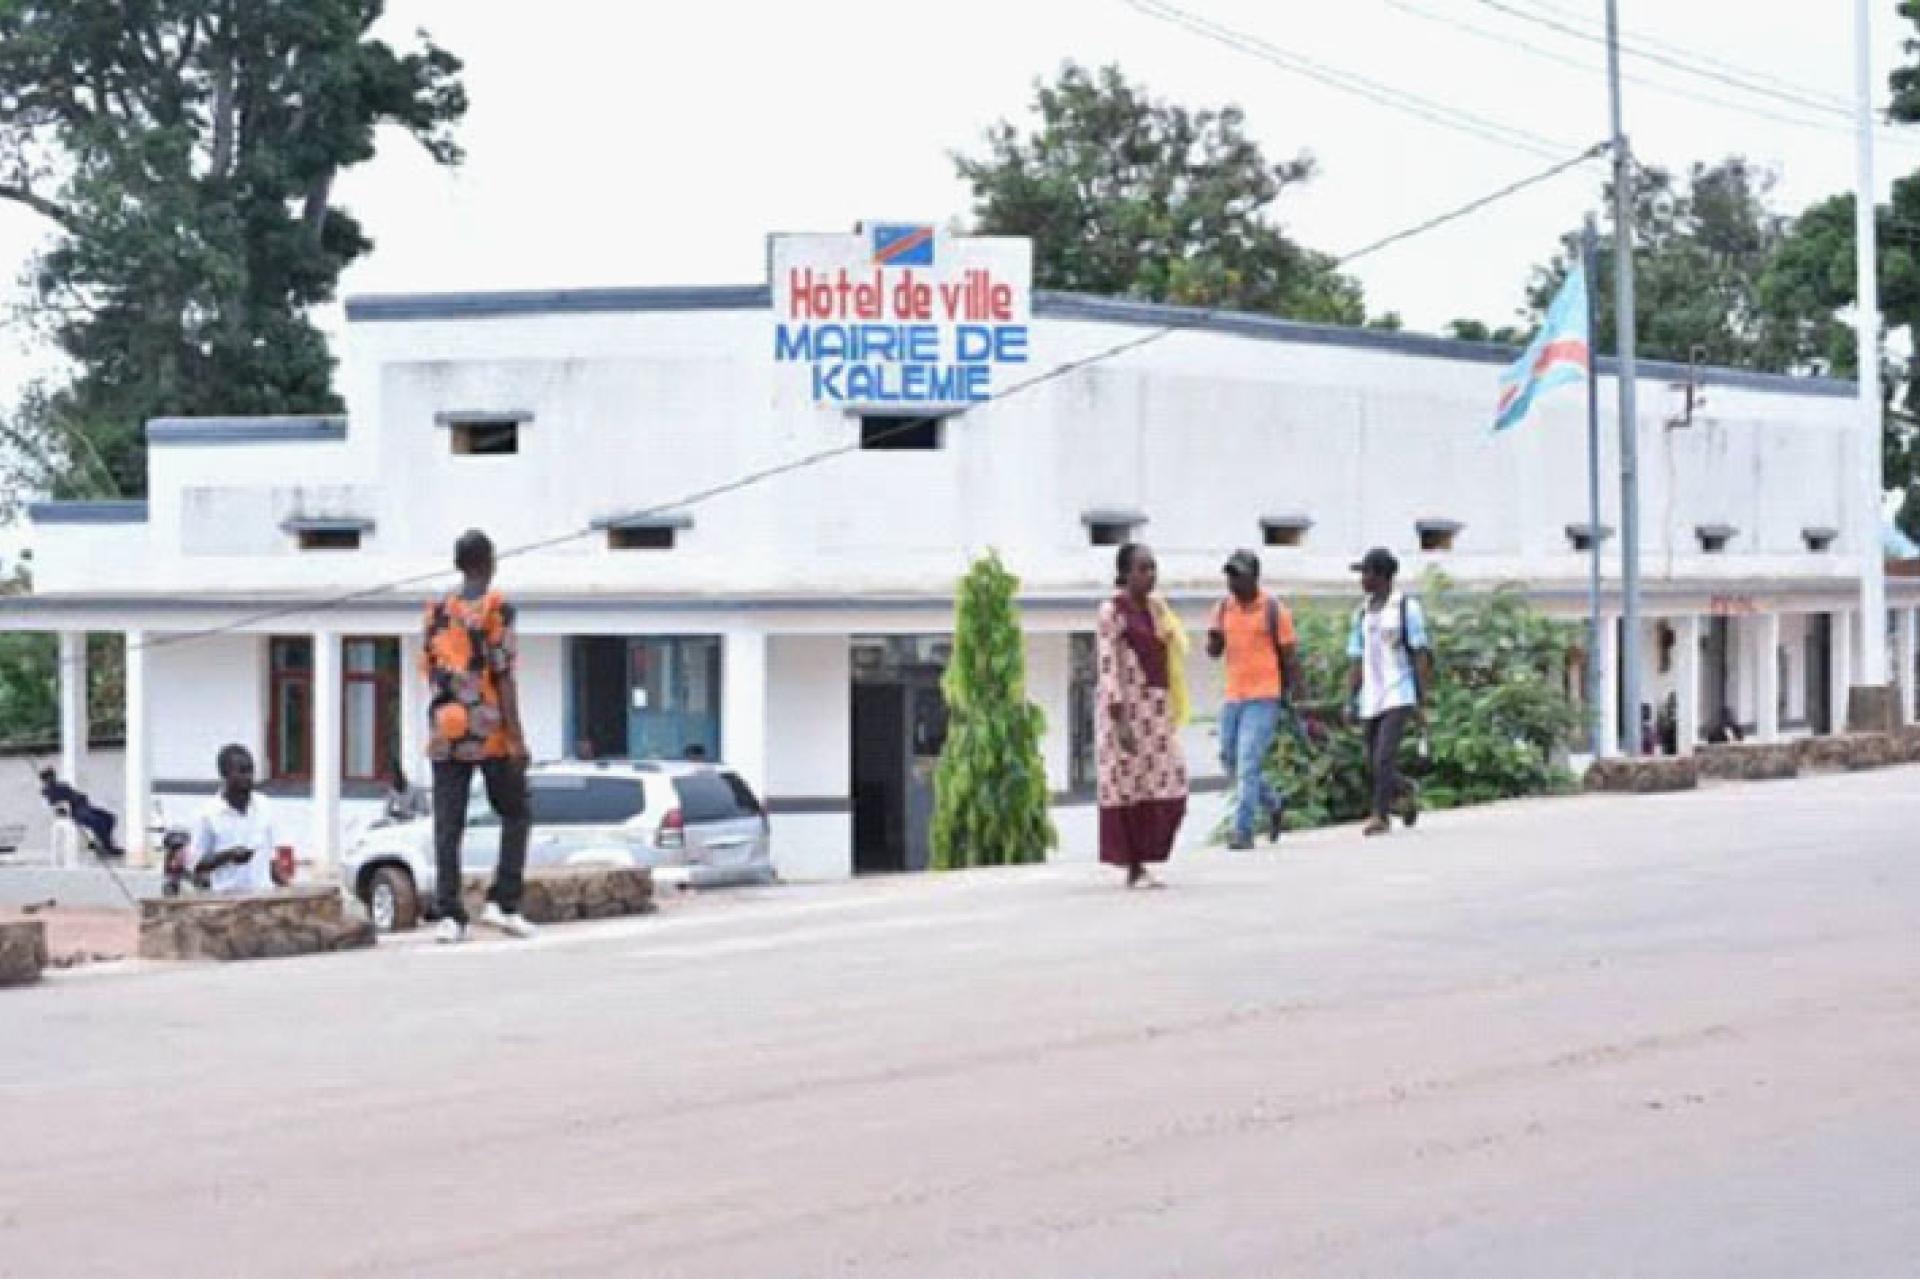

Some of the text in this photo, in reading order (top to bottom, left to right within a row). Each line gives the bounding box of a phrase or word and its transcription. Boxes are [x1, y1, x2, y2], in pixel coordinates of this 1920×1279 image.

[894, 267, 932, 319] de
[940, 268, 1012, 321] ville
[775, 324, 1027, 362] MAIRIE DE
[812, 364, 991, 401] KALEMIE
